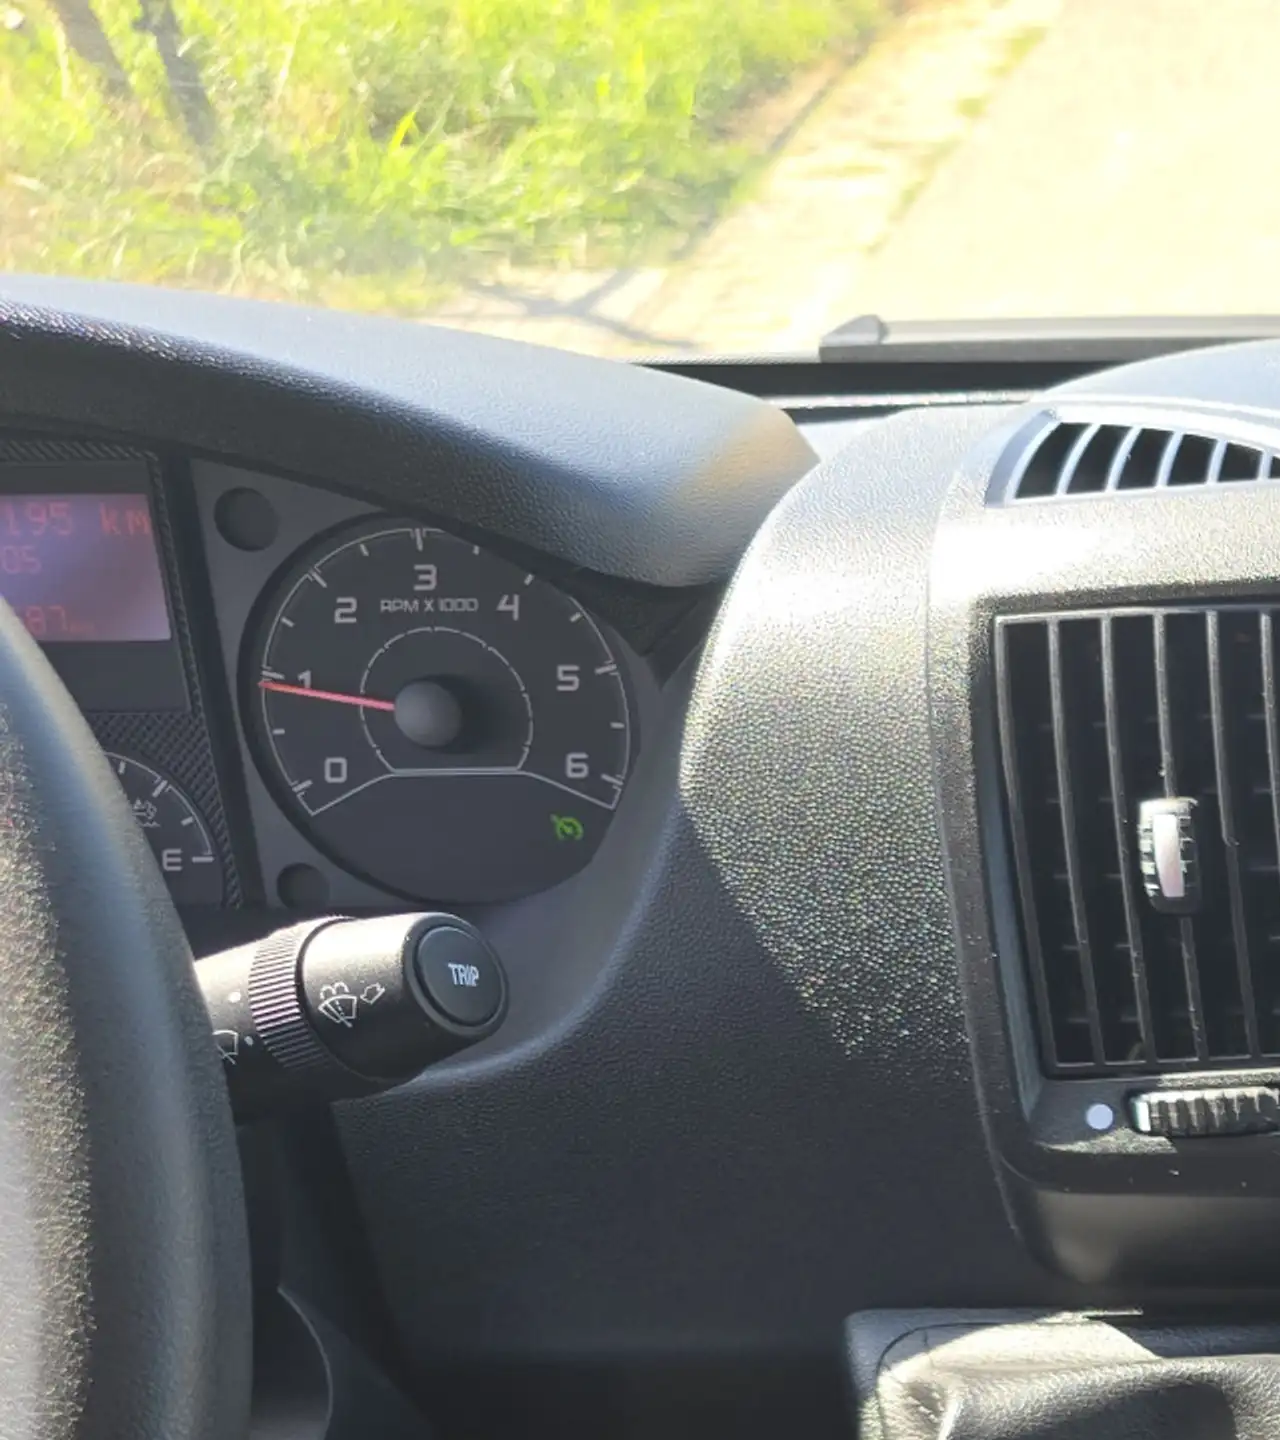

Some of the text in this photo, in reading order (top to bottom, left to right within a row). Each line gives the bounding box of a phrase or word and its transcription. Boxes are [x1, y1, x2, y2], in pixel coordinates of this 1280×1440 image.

[413, 564, 437, 591] 3
[334, 597, 357, 623] 2
[380, 599, 419, 613] RPM
[438, 598, 479, 612] 1000
[496, 594, 520, 621] 4
[556, 665, 579, 691] 5
[324, 757, 347, 783] 0
[565, 752, 589, 778] 6
[162, 848, 182, 871] E
[448, 963, 479, 987] TRIP
